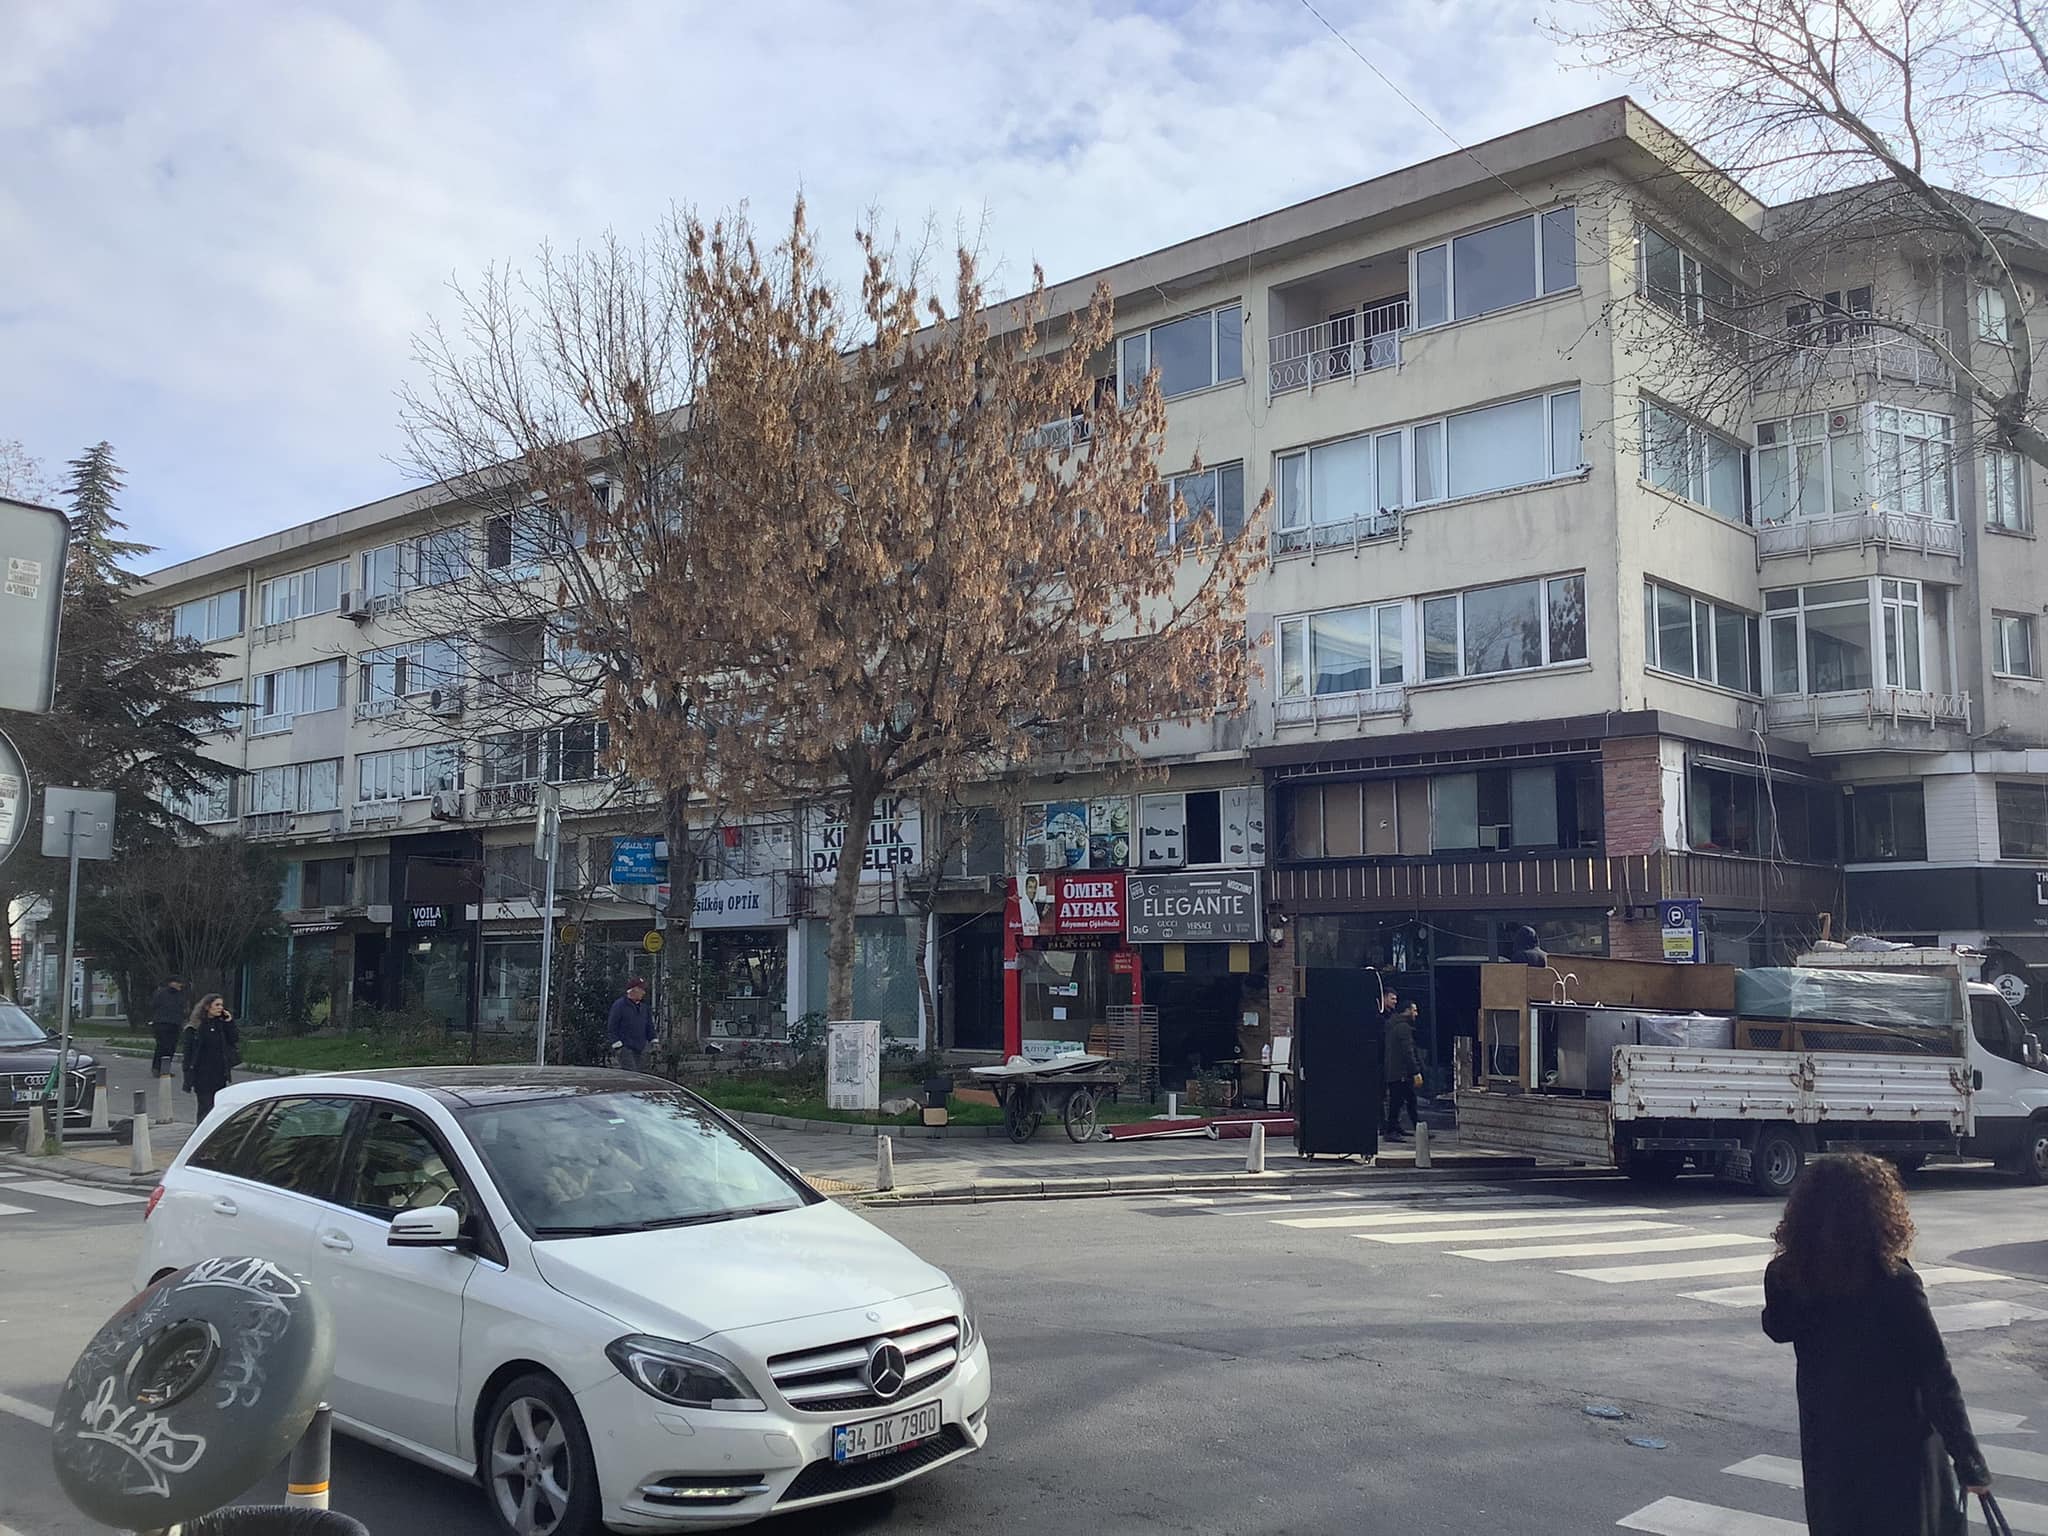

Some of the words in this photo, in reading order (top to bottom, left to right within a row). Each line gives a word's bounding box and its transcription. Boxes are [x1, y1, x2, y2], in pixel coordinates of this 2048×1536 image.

[813, 846, 914, 873] DAELER
[1063, 878, 1114, 899] ÖMER
[412, 906, 442, 920] VOILA
[692, 896, 724, 915] eşilköy
[727, 890, 760, 910] OPTİK
[1060, 901, 1119, 918] AYBAK
[1143, 895, 1244, 917] ELEGANTE
[1157, 920, 1178, 928] GUCCI
[846, 1427, 866, 1454] 34
[874, 1419, 893, 1448] DK
[901, 1407, 937, 1441] 7900
